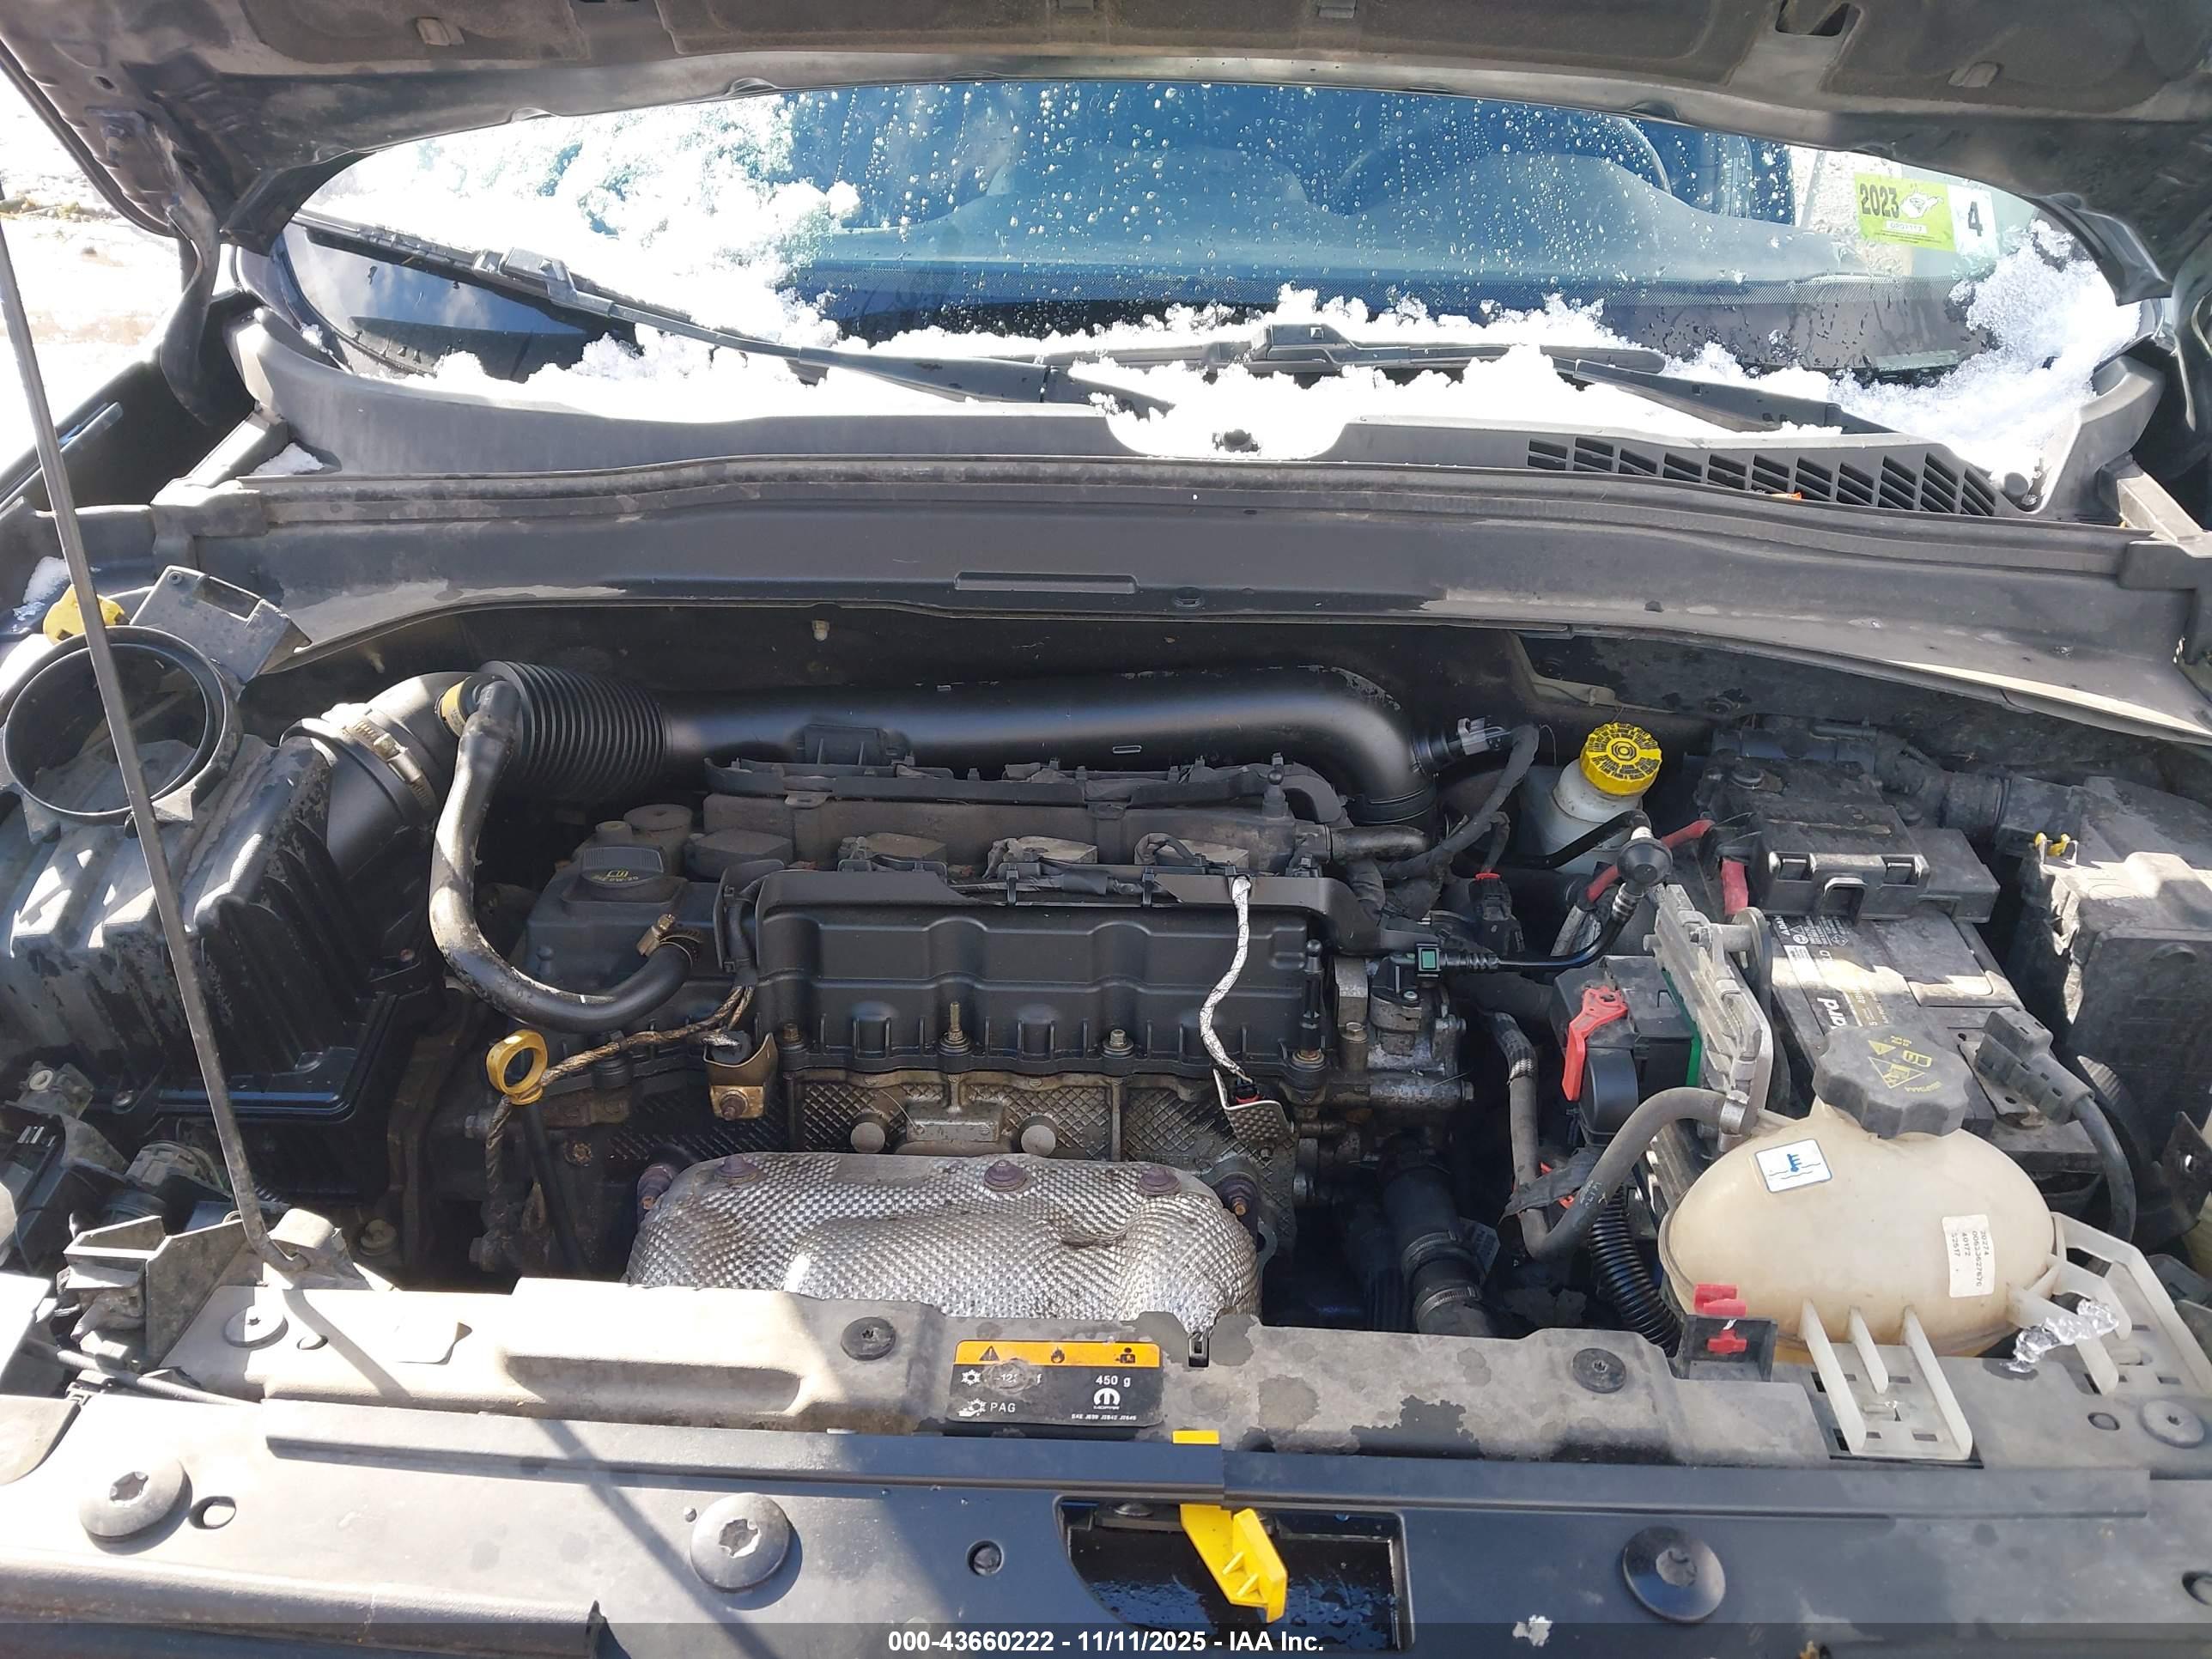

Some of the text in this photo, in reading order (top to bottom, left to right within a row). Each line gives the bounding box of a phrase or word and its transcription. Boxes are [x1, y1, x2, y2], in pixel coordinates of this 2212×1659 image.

[1859, 183, 1899, 219] 2023
[1966, 201, 1984, 237] 4
[1095, 1375, 1119, 1385] 450
[1123, 1376, 1132, 1388] g
[989, 1402, 1017, 1413] PAG
